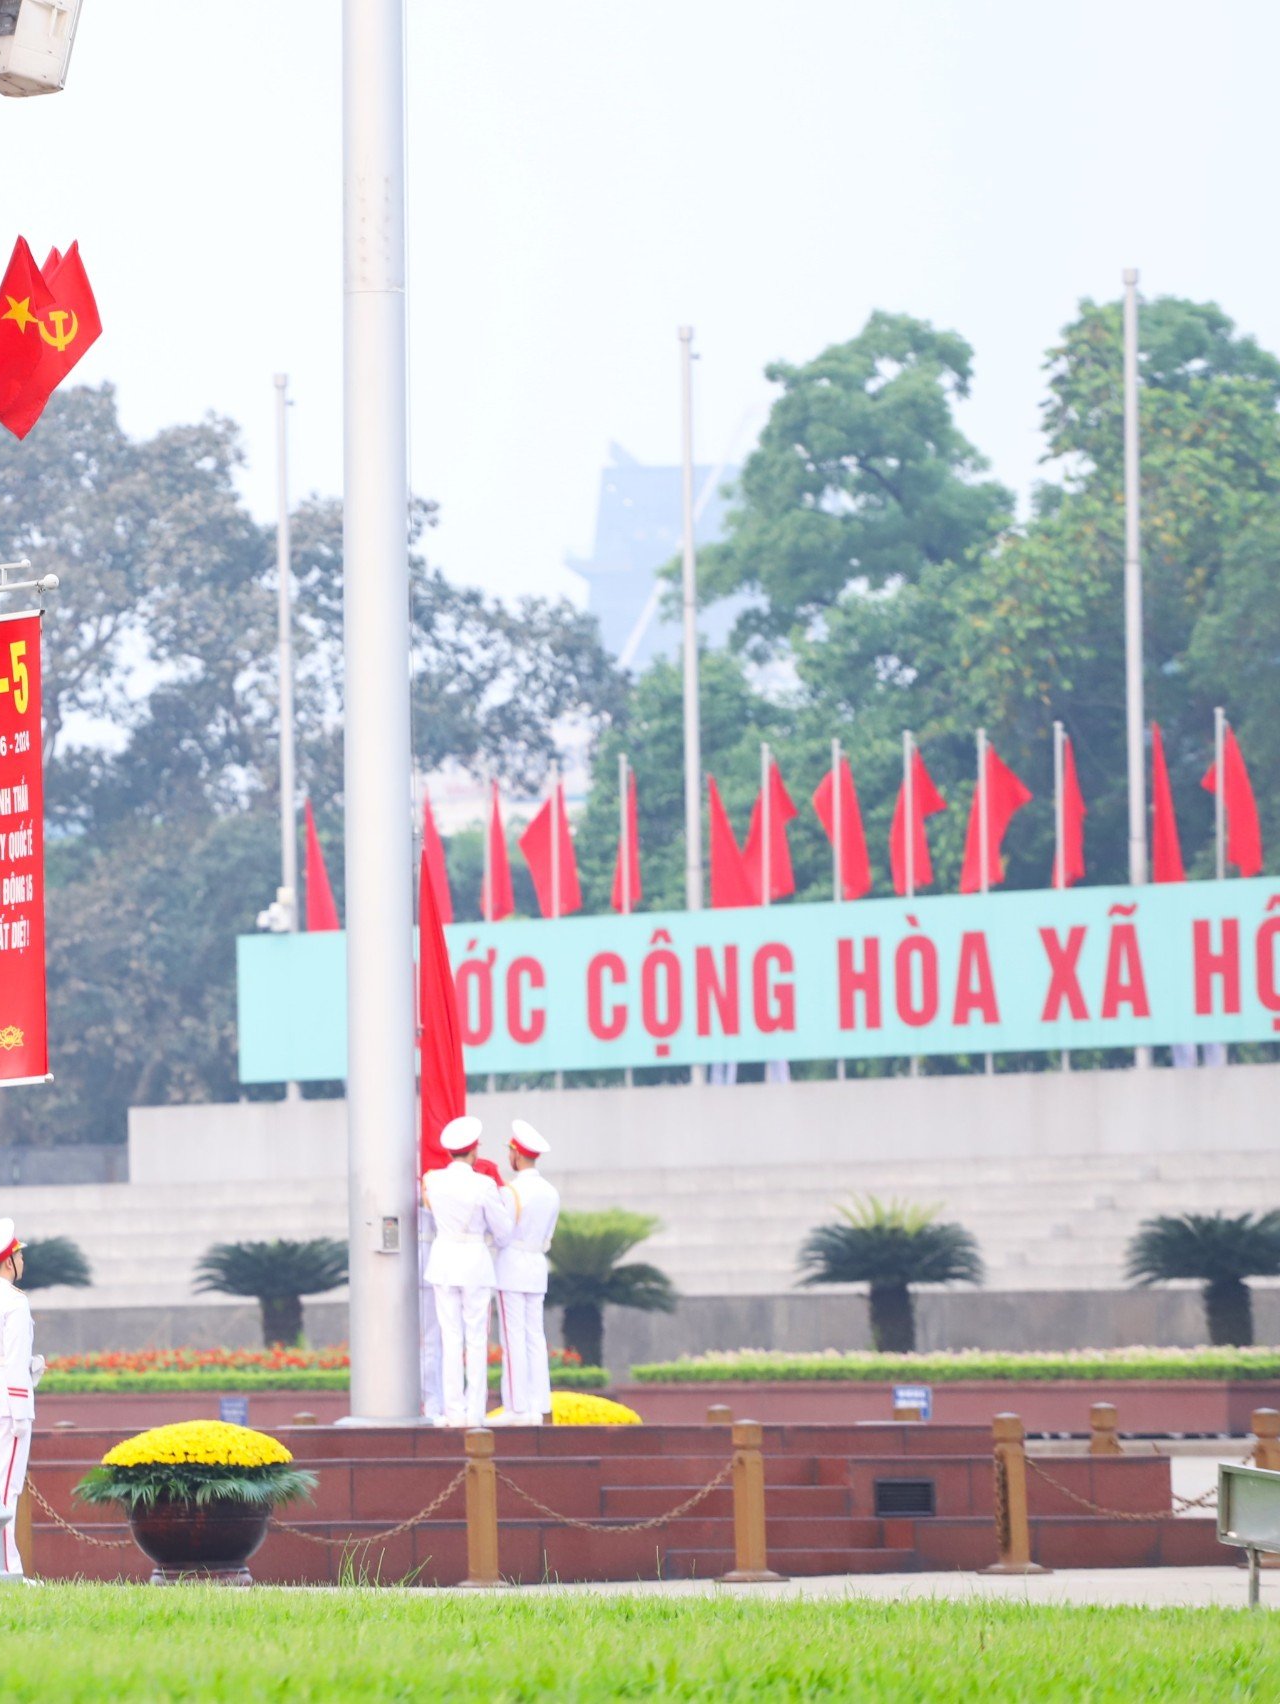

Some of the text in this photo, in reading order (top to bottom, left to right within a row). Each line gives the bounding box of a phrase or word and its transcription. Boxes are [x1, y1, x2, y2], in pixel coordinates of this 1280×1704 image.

[414, 938, 546, 1047] ỚC
[586, 928, 797, 1057] CỘNG
[837, 913, 1001, 1031] HÒA
[1038, 902, 1151, 1022] XÃ
